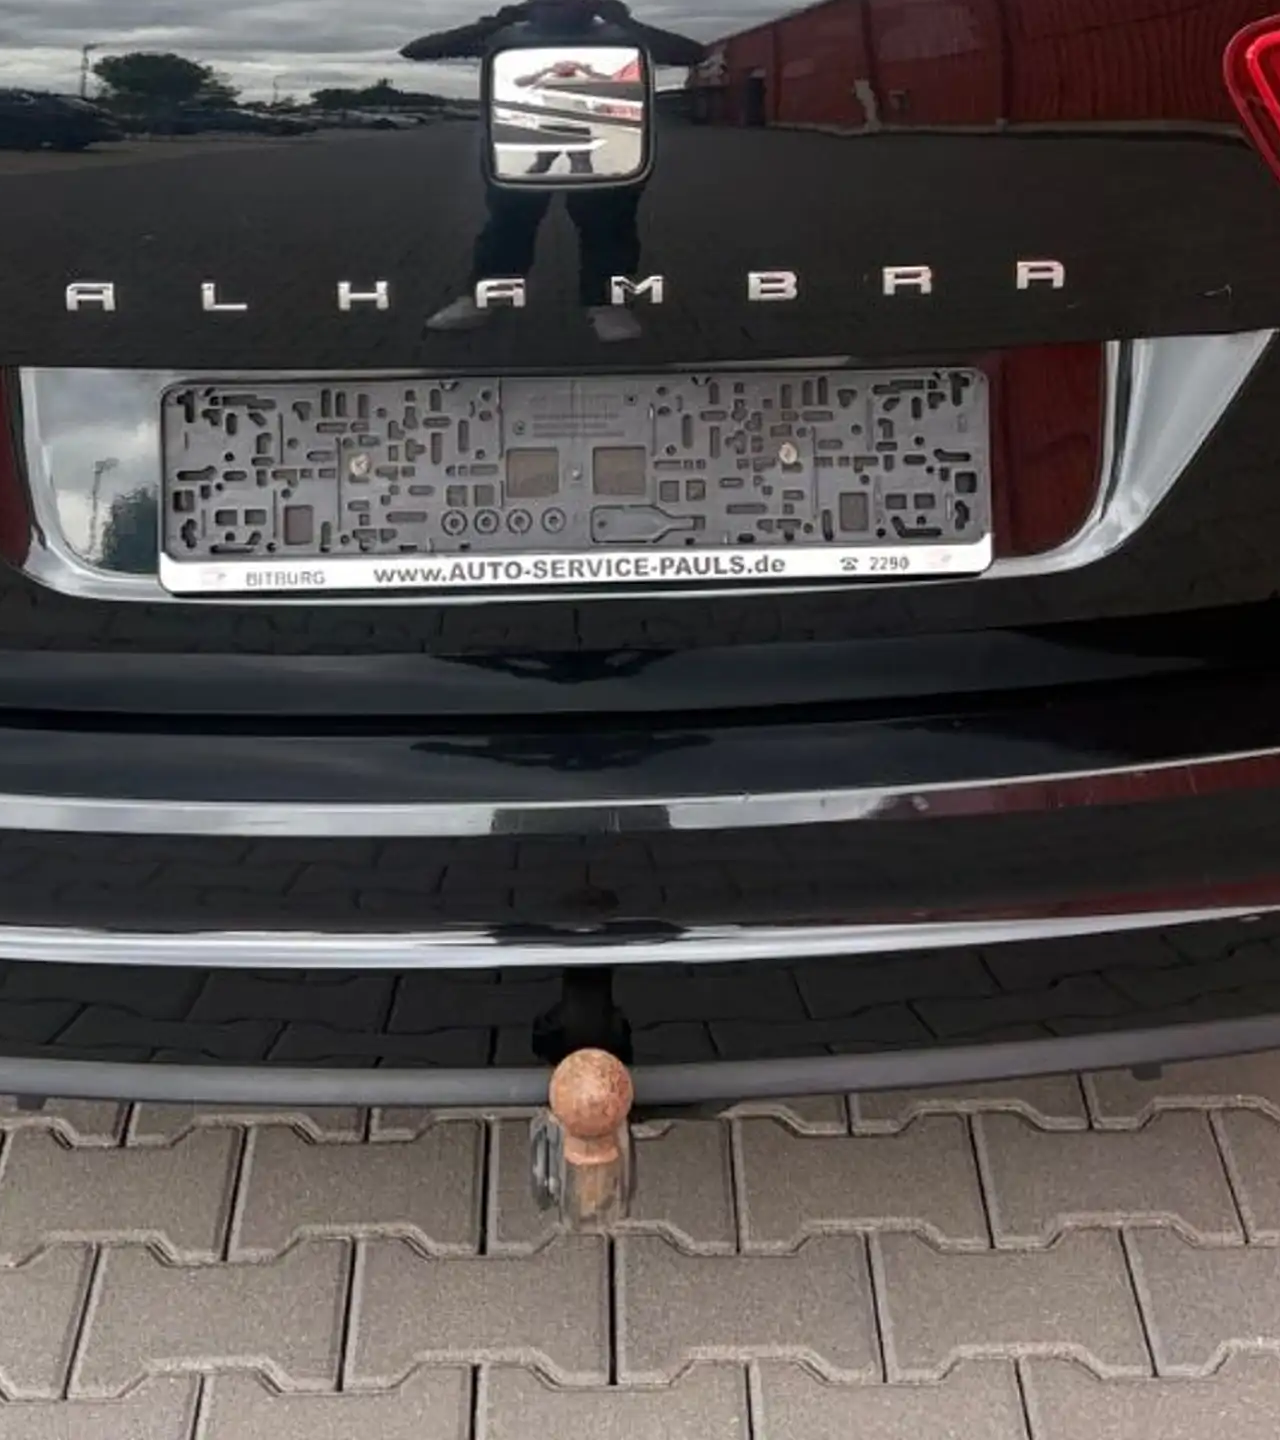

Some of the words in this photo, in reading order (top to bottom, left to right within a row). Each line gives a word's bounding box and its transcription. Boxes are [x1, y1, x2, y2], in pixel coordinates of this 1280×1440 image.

[65, 259, 1065, 312] ALHAMBRA
[245, 570, 326, 587] BITBURG
[373, 554, 786, 583] www.AUTO-SERVICE-PAULS.de
